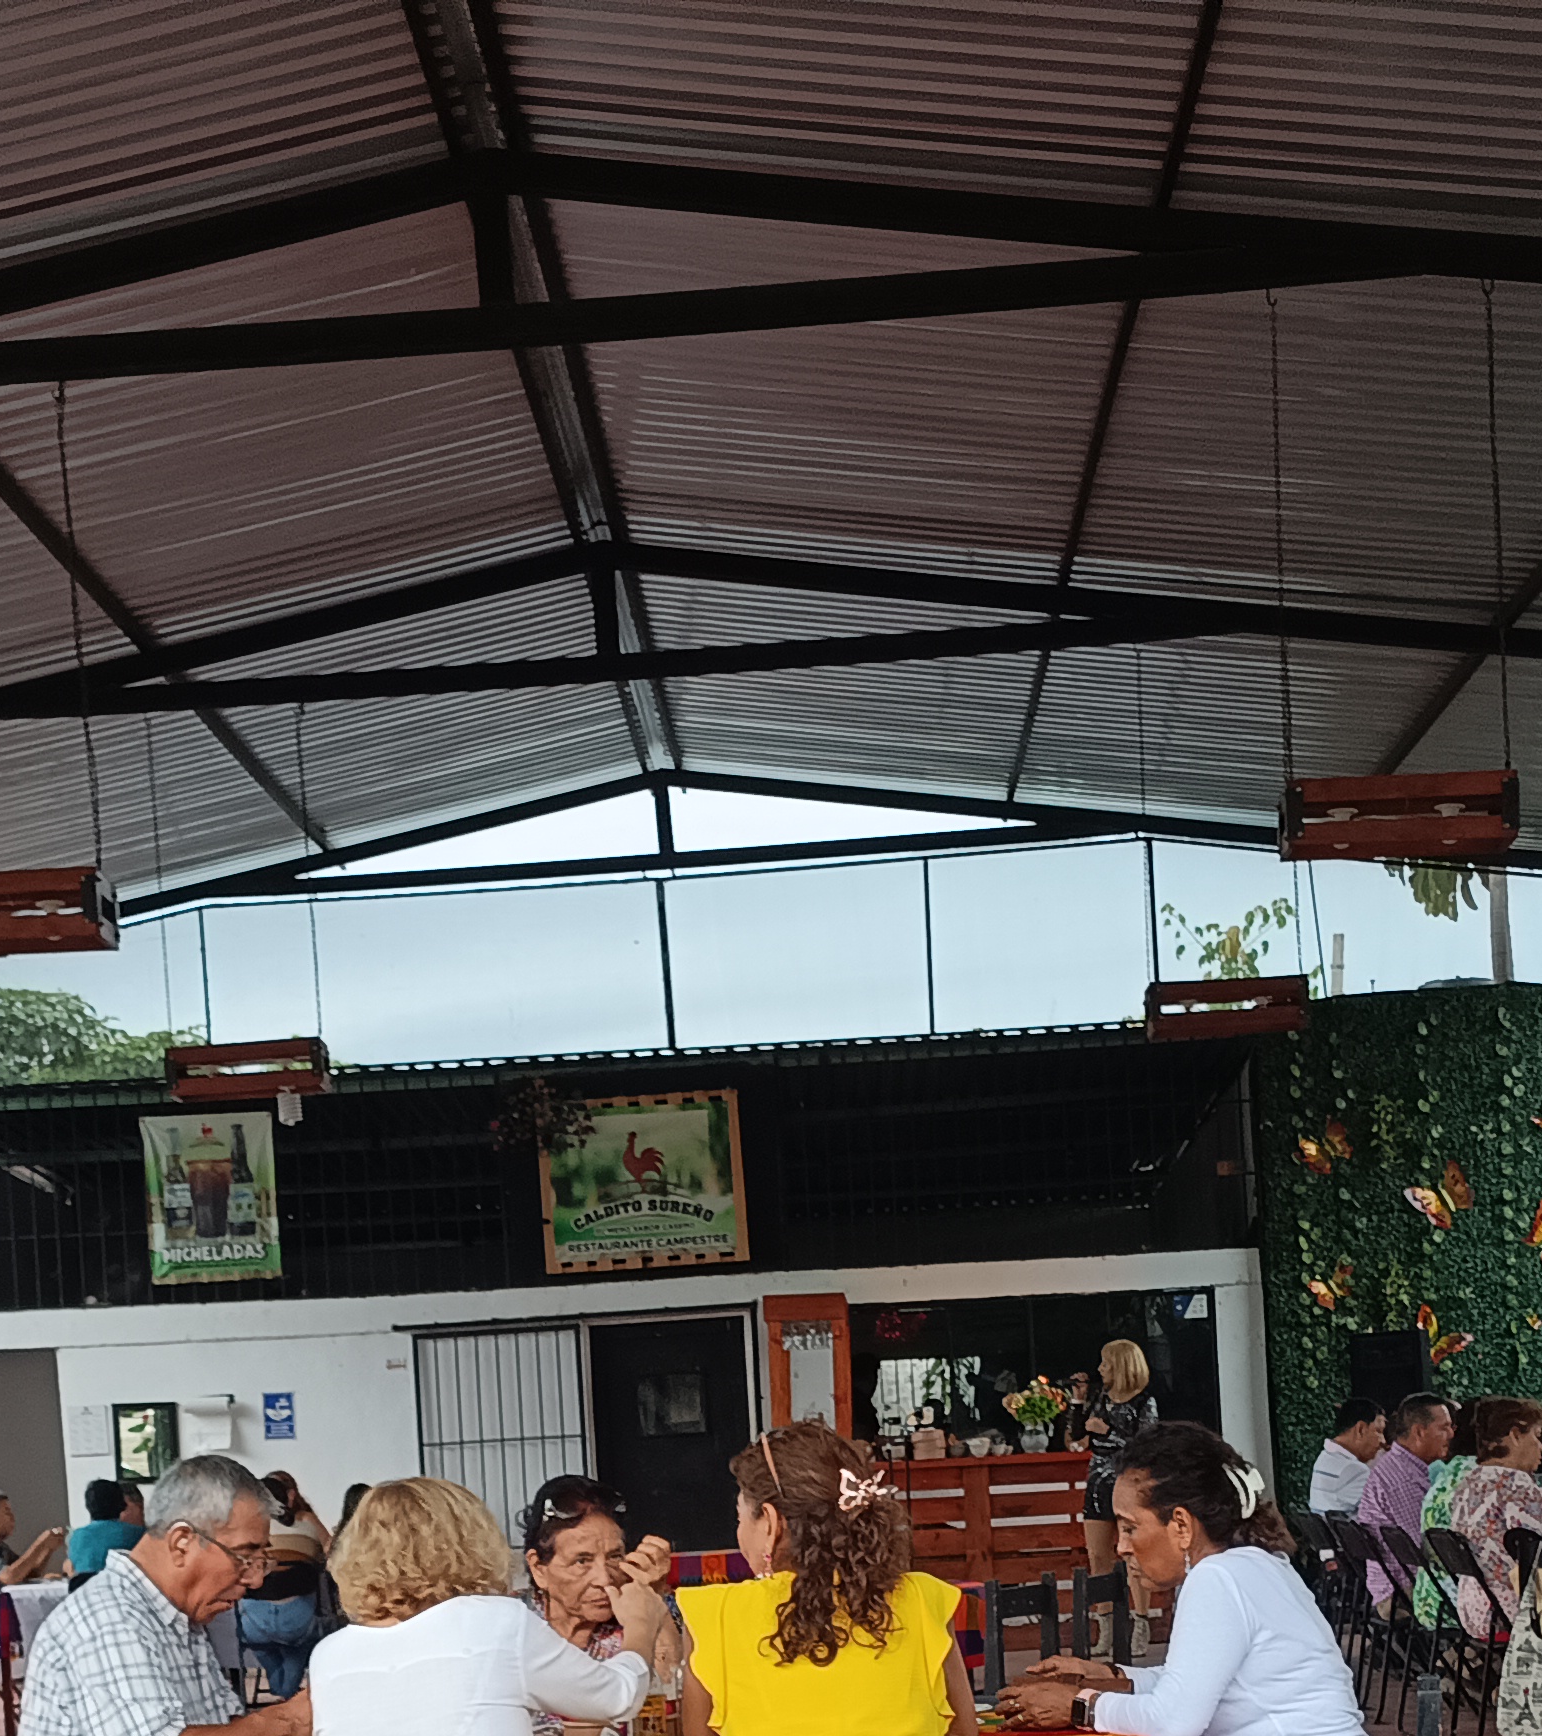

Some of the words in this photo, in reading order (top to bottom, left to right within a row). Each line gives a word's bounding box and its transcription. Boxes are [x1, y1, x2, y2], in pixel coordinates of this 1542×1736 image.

[573, 1200, 643, 1231] CALDITO
[647, 1200, 715, 1223] SUREÑO
[162, 1243, 266, 1263] MICHELADAS
[568, 1238, 653, 1253] RESTAURANTE
[656, 1233, 729, 1248] CAMPESTRE
